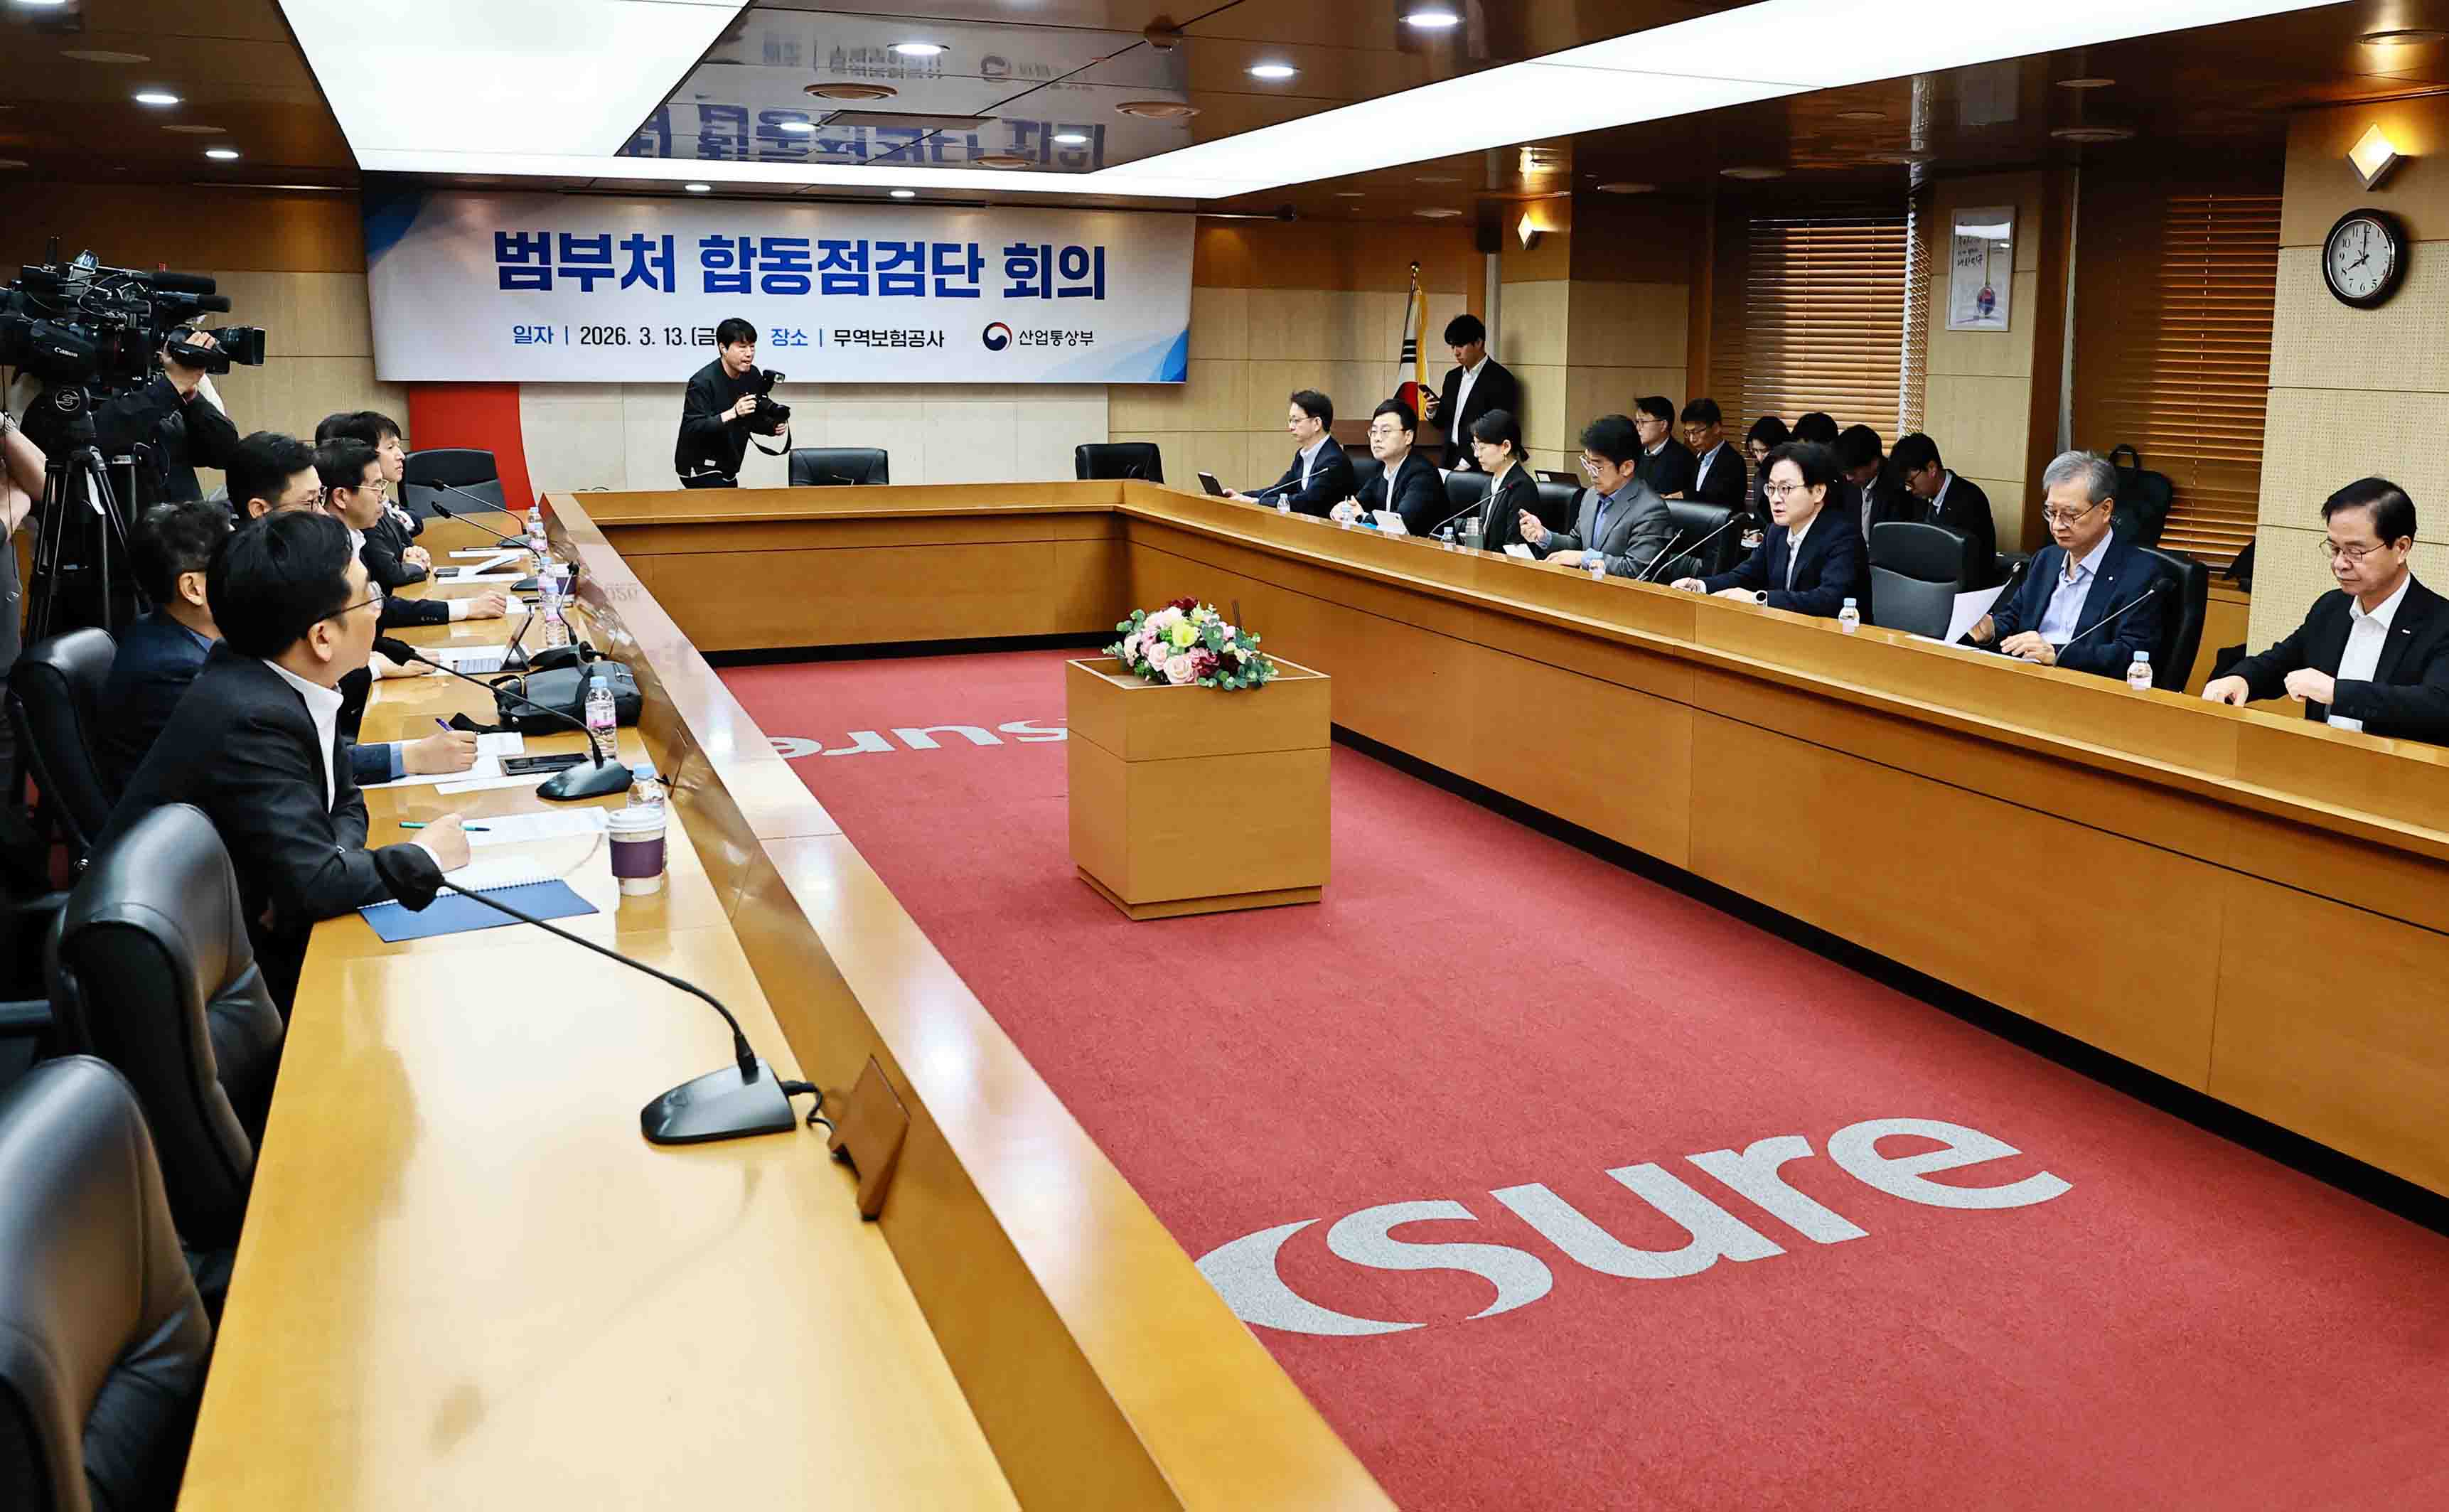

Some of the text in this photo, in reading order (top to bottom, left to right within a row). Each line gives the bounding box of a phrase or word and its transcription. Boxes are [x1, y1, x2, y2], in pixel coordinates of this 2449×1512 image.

[2342, 238, 2351, 248] 10
[2339, 252, 2345, 262] 9
[495, 231, 1105, 300] 범부처 합동점검단 회의
[2359, 281, 2366, 291] 6
[2371, 279, 2378, 289] 5
[512, 325, 717, 347] 일자 2026. 3. 13.(금
[771, 328, 945, 348] 장소 무역보험공사
[1019, 329, 1095, 347] 산업통상부
[54, 346, 79, 358] Canon
